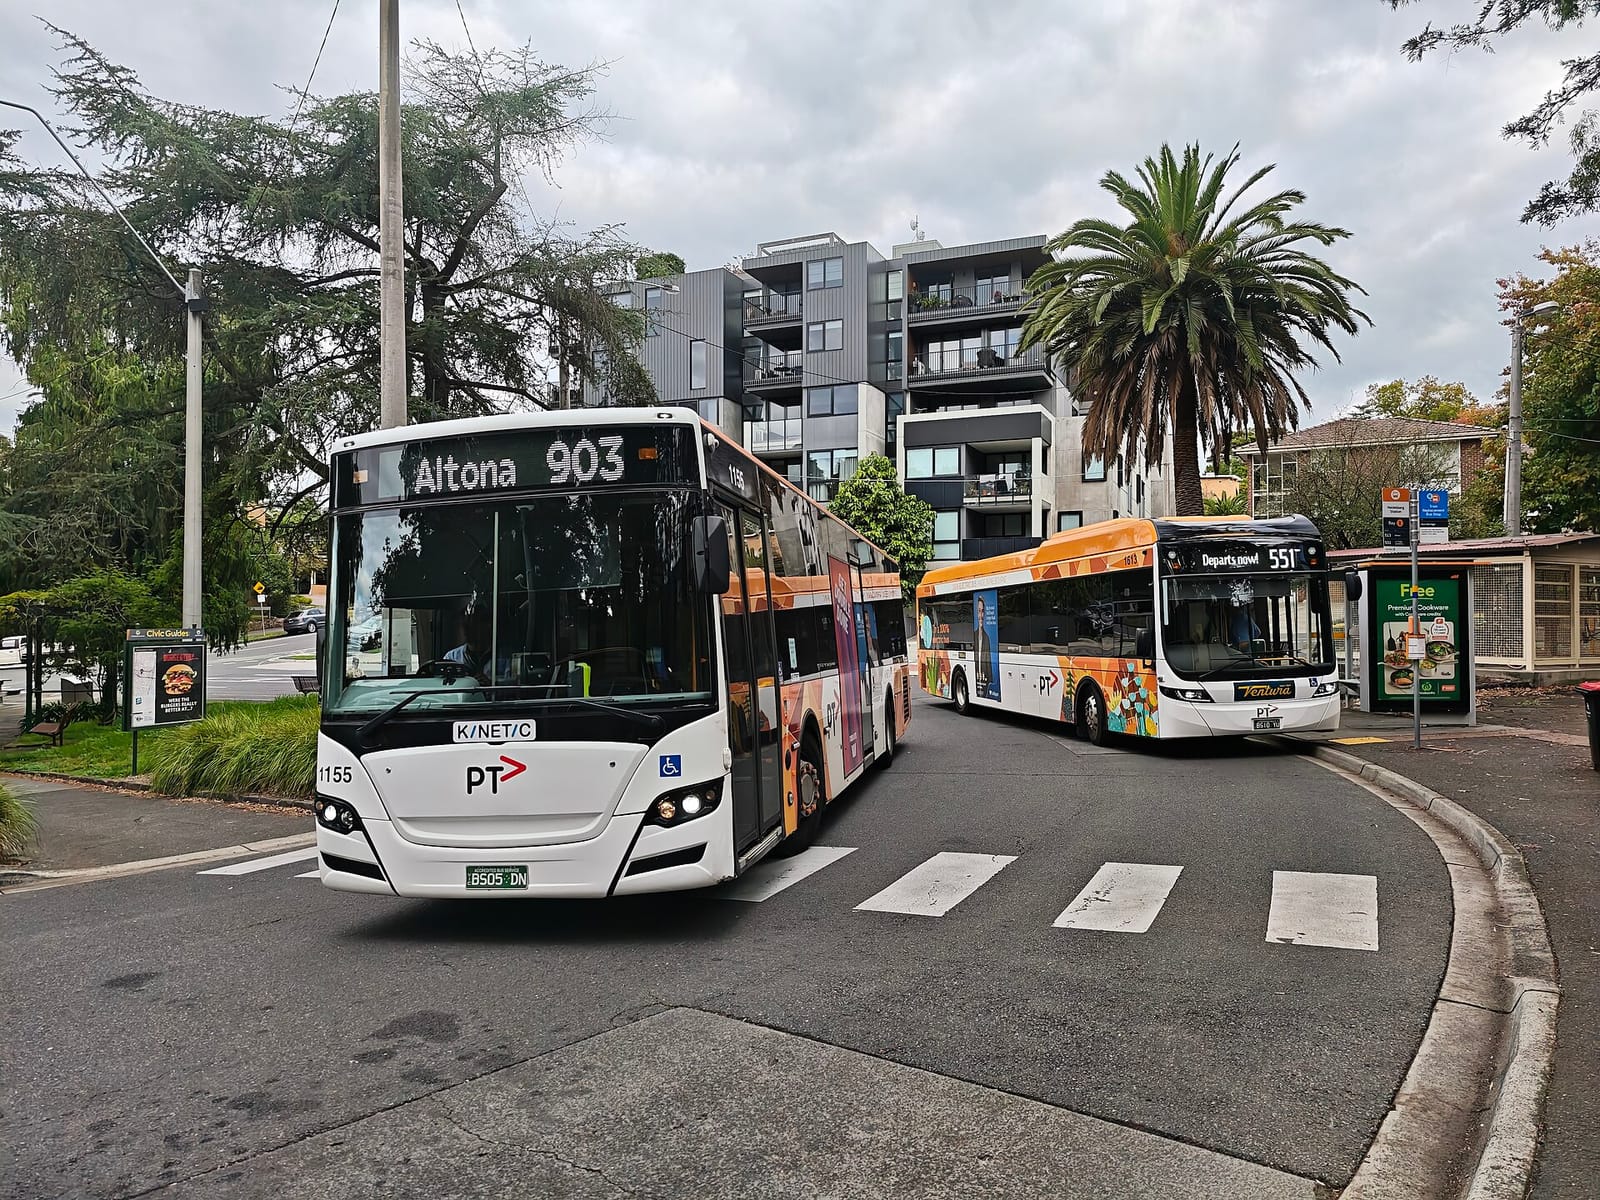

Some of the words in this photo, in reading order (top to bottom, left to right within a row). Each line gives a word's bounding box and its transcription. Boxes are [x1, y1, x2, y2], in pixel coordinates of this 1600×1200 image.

[415, 455, 516, 493] Altona
[546, 435, 625, 483] 903
[728, 463, 745, 490] 1155
[1124, 553, 1138, 566] 1613
[1202, 554, 1237, 569] Departs
[1237, 552, 1259, 566] now!
[1268, 548, 1295, 569] 551
[146, 629, 165, 638] Civic
[165, 629, 189, 638] Guides
[1238, 685, 1292, 698] Ventura
[320, 765, 353, 784] 1155
[510, 872, 527, 886] DN
